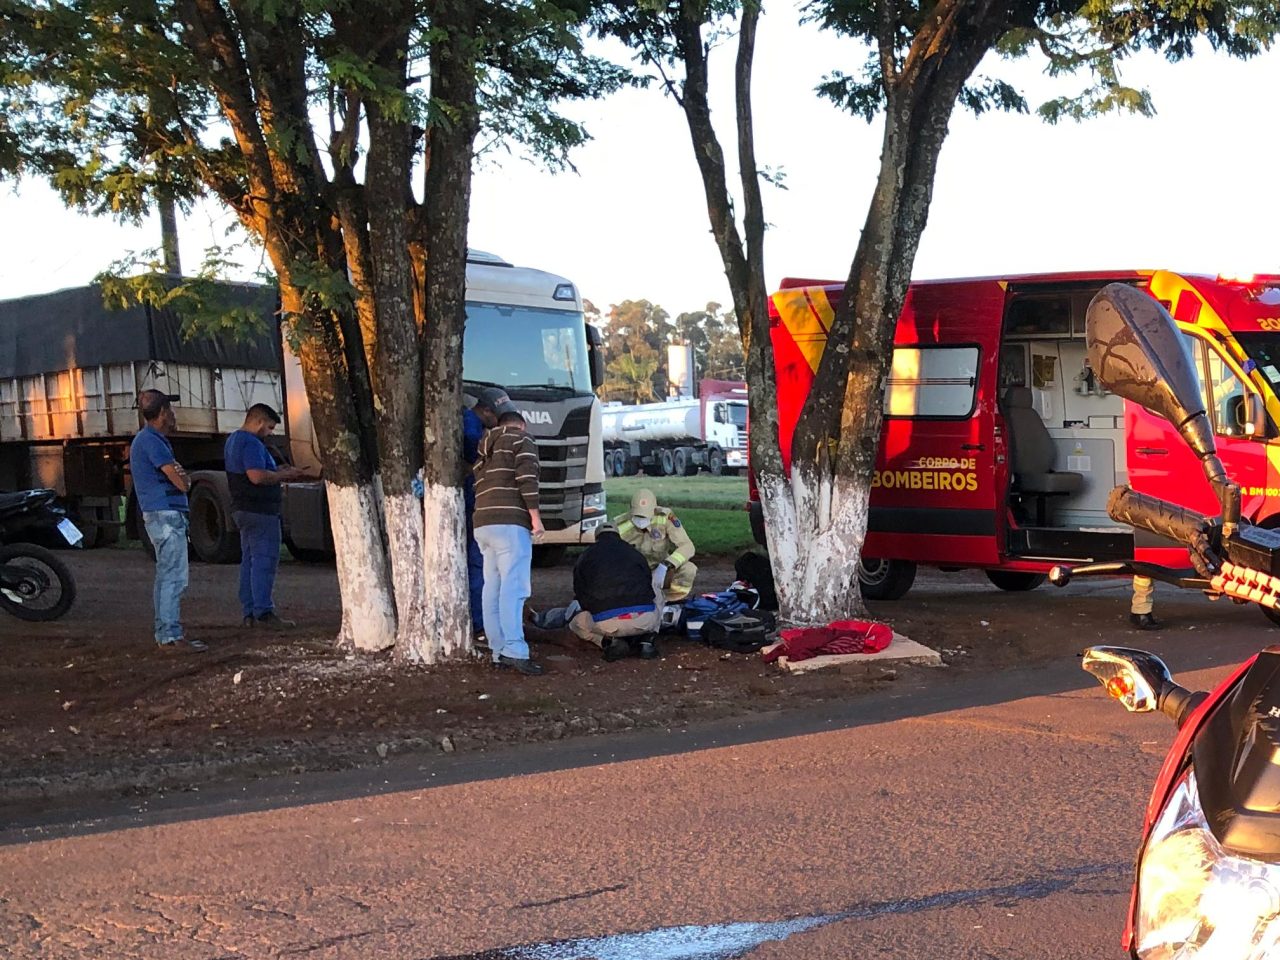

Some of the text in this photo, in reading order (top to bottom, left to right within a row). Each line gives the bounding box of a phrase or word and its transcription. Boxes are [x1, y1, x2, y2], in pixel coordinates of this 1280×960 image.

[919, 457, 976, 470] CORPO DE
[871, 470, 978, 491] BOMBEIROS
[1249, 487, 1263, 496] BM
